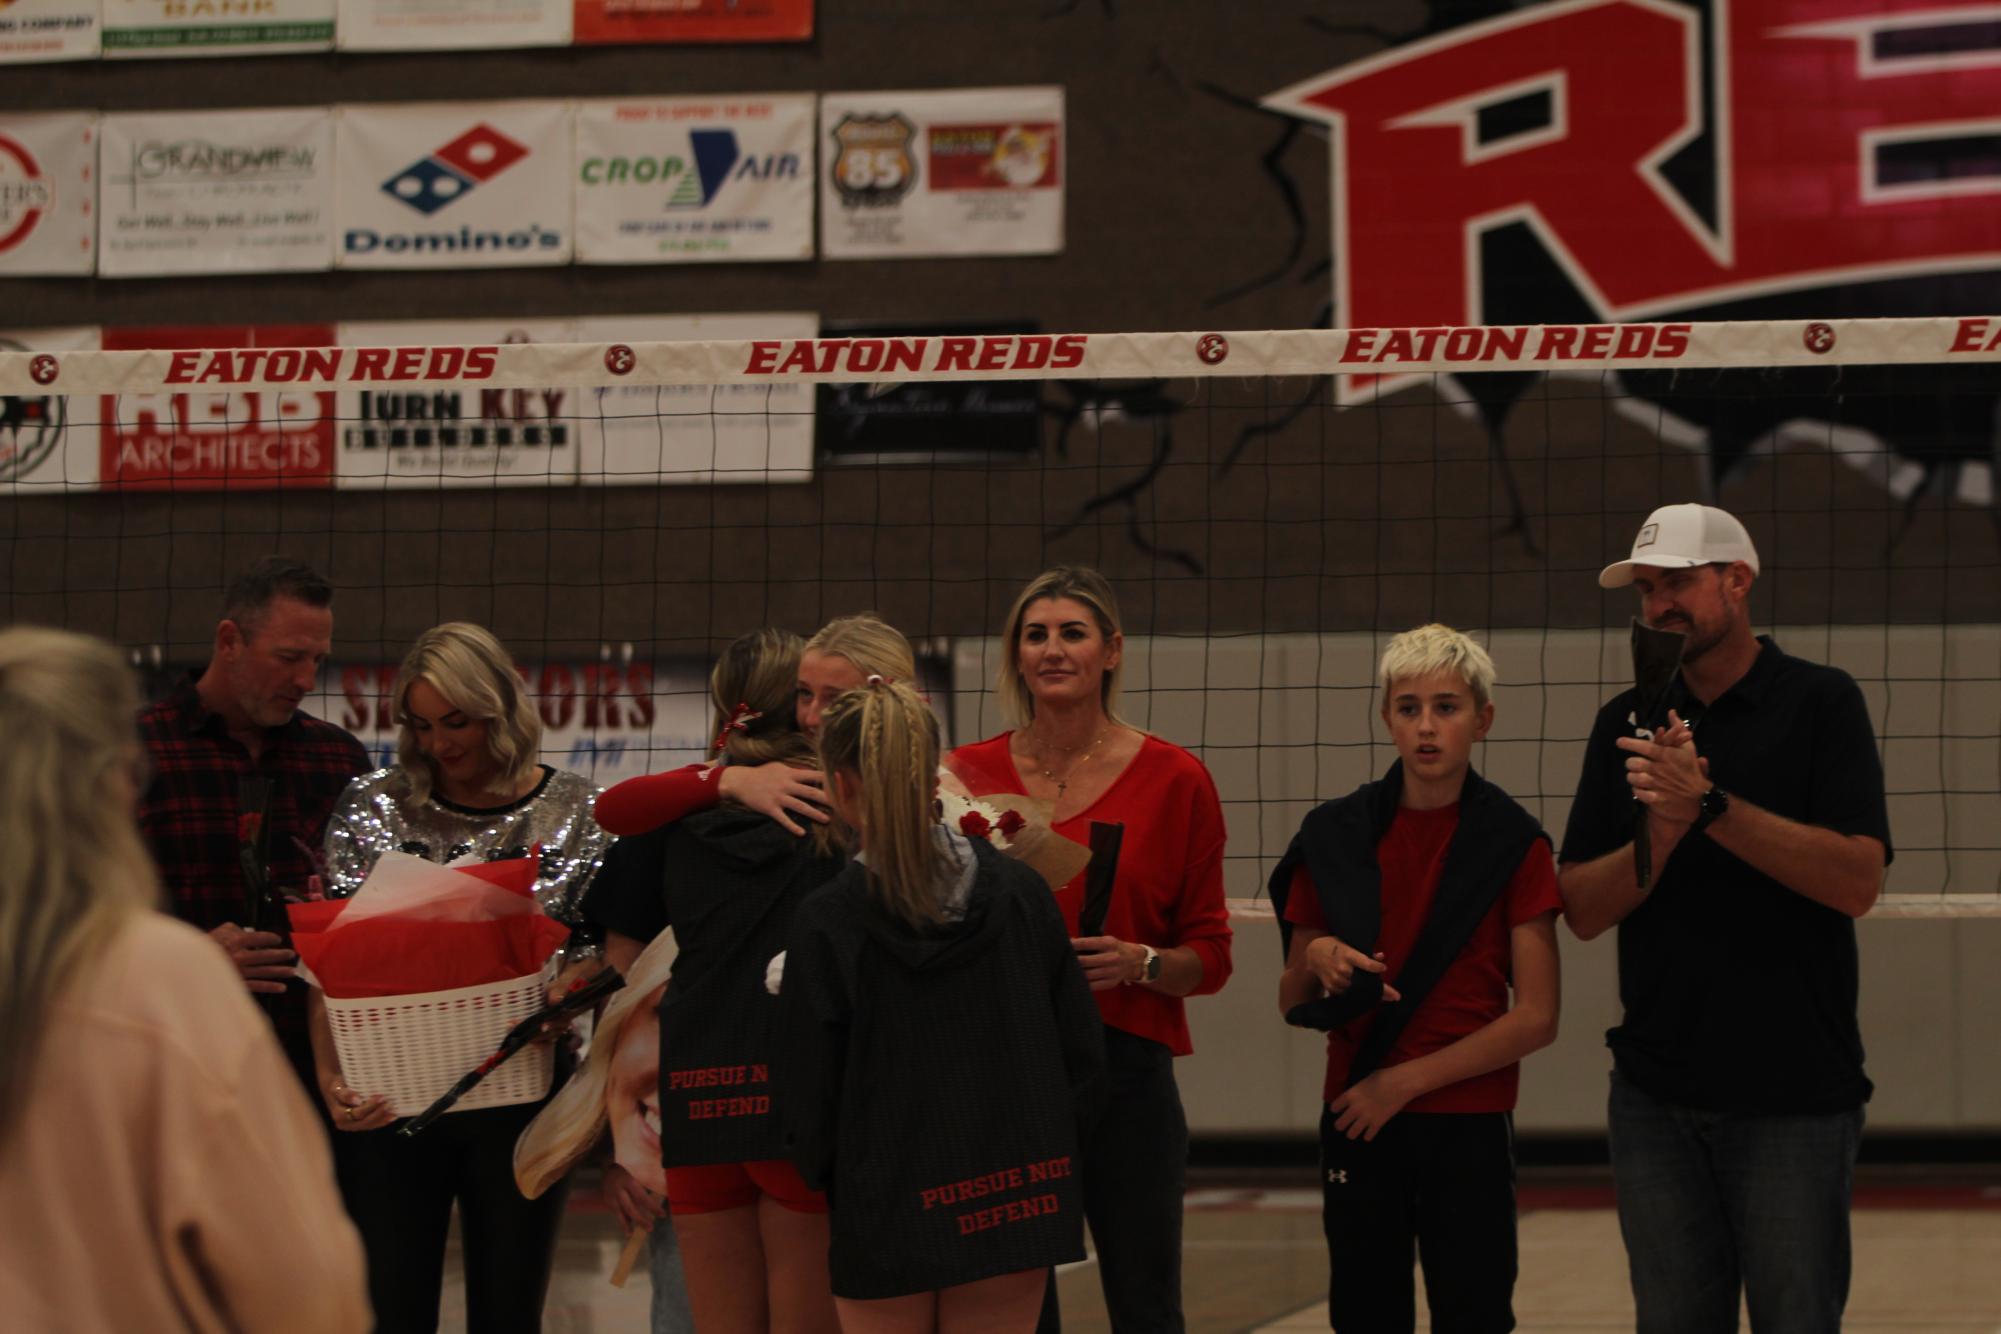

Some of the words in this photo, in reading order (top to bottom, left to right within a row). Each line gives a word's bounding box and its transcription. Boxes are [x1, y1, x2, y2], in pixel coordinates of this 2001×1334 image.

[580, 156, 684, 185] CROP
[734, 154, 799, 181] AIR
[843, 148, 903, 190] 85
[344, 224, 560, 253] Domino's
[743, 339, 928, 375] EATON
[932, 335, 1088, 371] REDS
[1338, 328, 1531, 364] EATON
[1533, 324, 1692, 361] REDS
[163, 349, 343, 384] EATON
[347, 346, 498, 381] REDS
[116, 433, 321, 472] ARCHITECTS
[342, 661, 656, 731] SEORS
[668, 1065, 747, 1090] PURSUE
[688, 1094, 770, 1120] DEFEND
[920, 1167, 1023, 1210] PURSUE
[1028, 1156, 1073, 1185] NOT
[957, 1194, 1060, 1235] DEFEND
